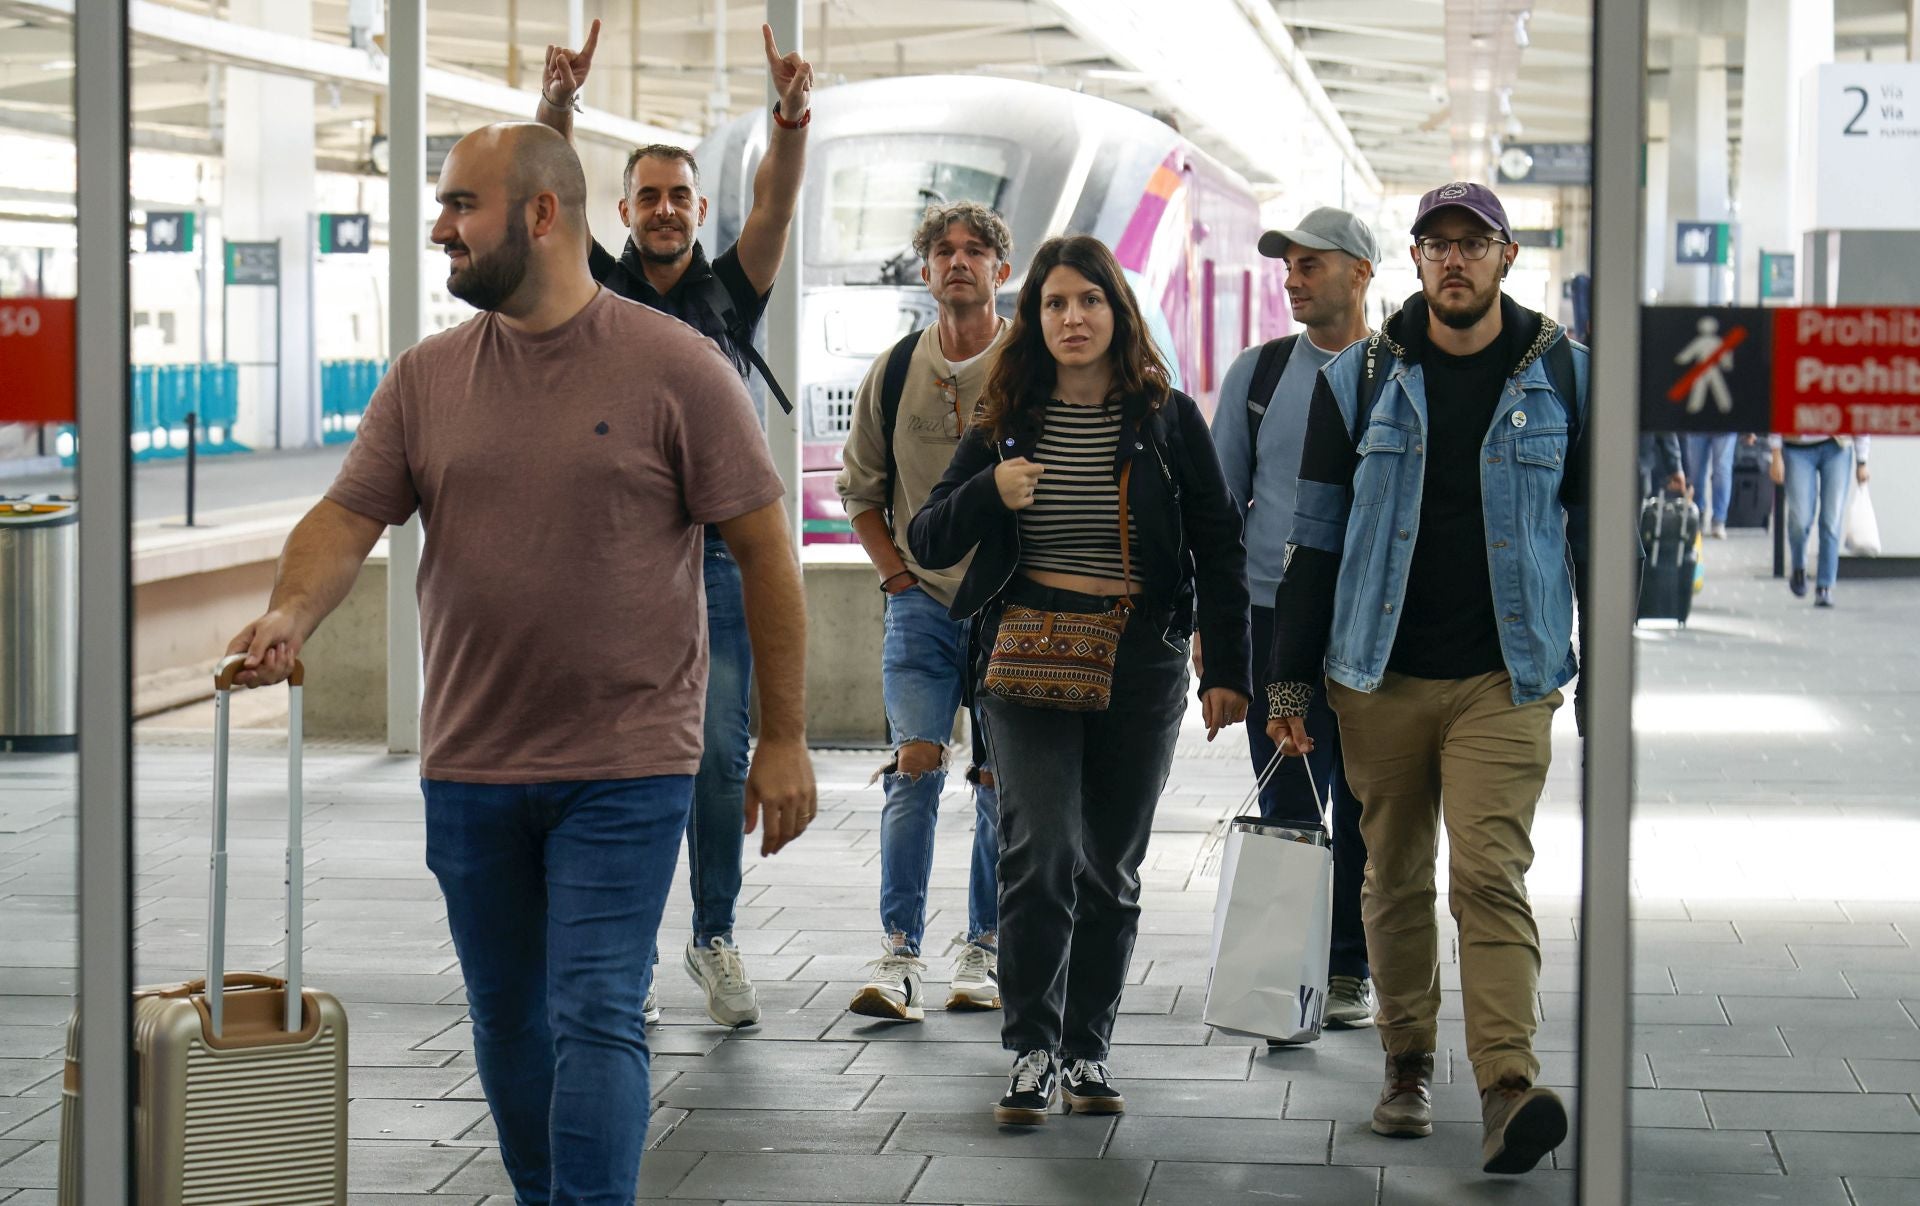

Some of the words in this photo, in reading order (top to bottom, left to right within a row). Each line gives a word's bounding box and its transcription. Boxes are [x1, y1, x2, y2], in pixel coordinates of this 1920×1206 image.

[1843, 86, 1869, 136] 2
[1797, 310, 1920, 346] Prohib
[1796, 357, 1920, 394] Prohib
[1795, 404, 1842, 432] NO
